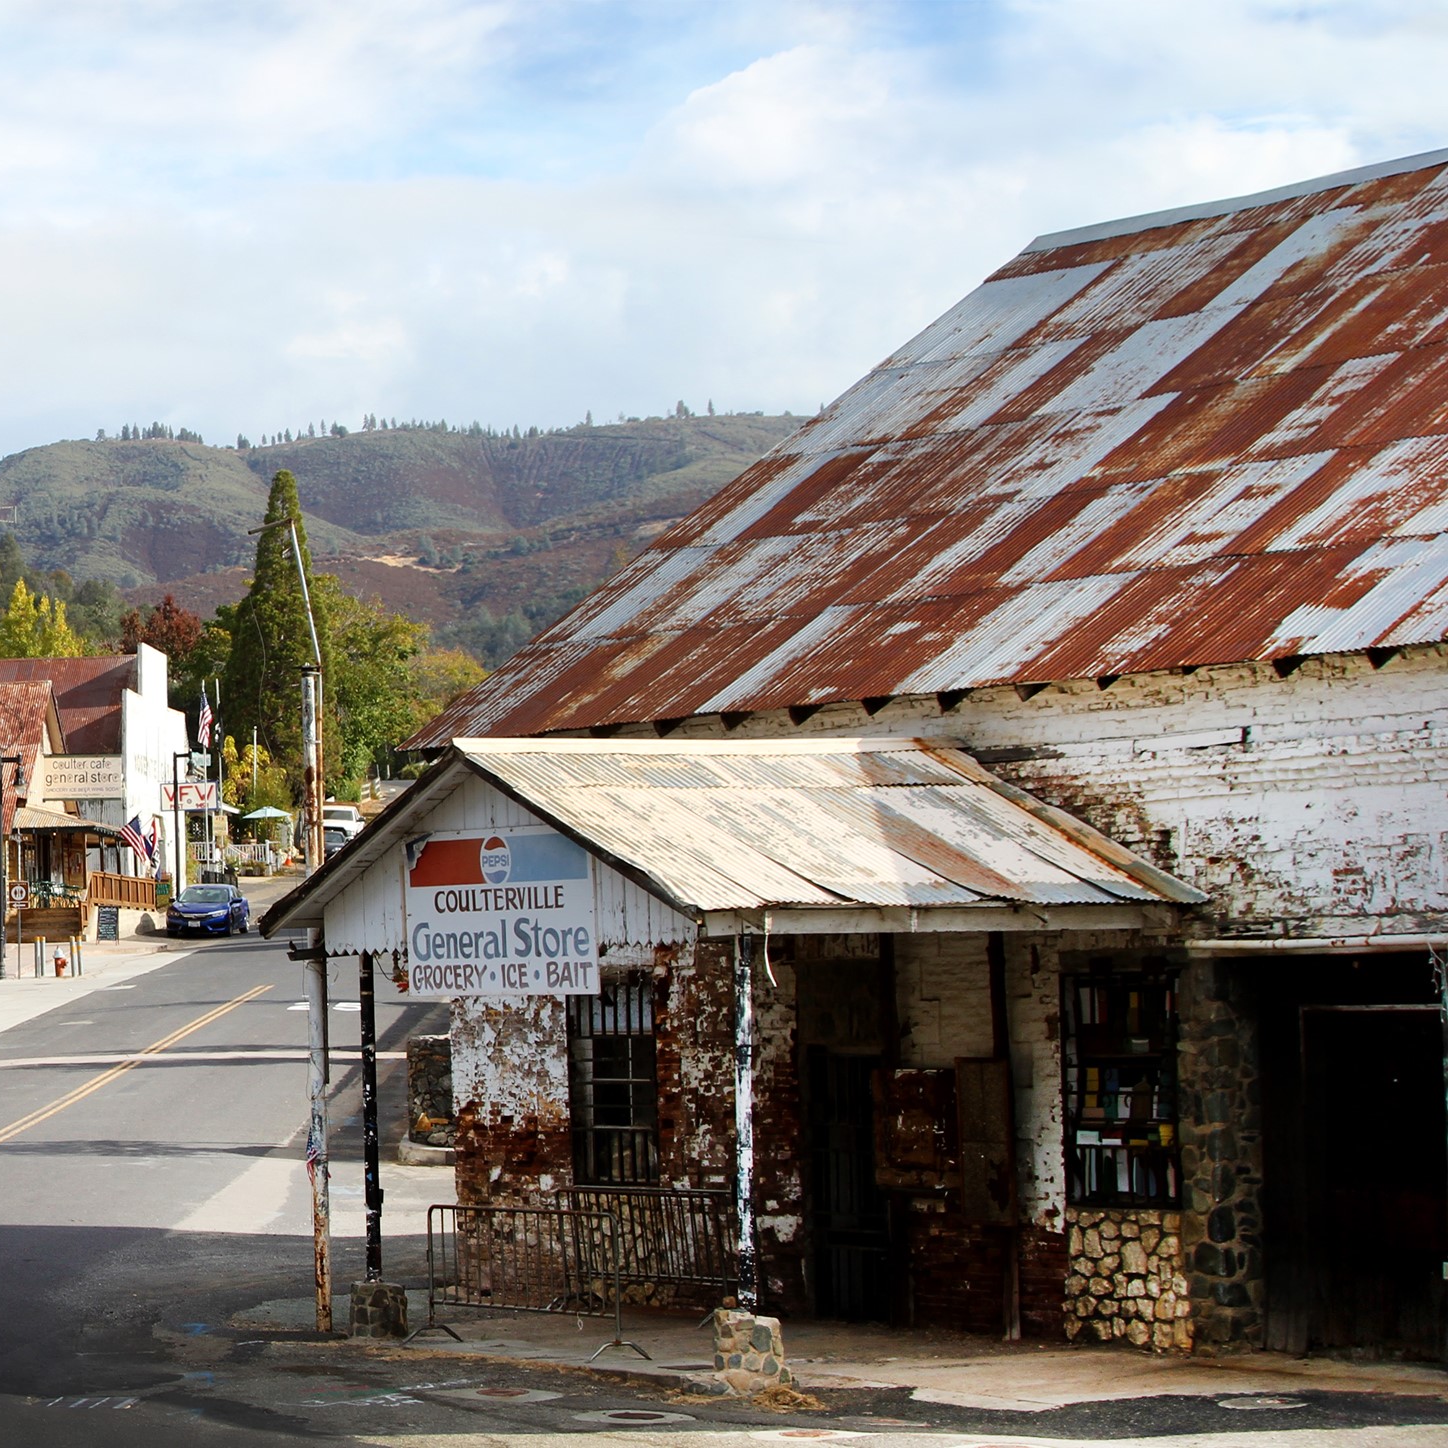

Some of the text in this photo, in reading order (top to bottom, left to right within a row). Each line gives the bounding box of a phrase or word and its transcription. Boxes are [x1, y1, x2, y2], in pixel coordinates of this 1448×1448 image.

[53, 757, 112, 770] coulter cafe
[45, 772, 119, 787] general store
[164, 784, 214, 802] VFW
[482, 854, 510, 868] PEPSI
[434, 885, 565, 914] COULTERVILLE
[412, 917, 590, 962] General Store
[412, 961, 593, 991] GROCERY ICE BAIT
